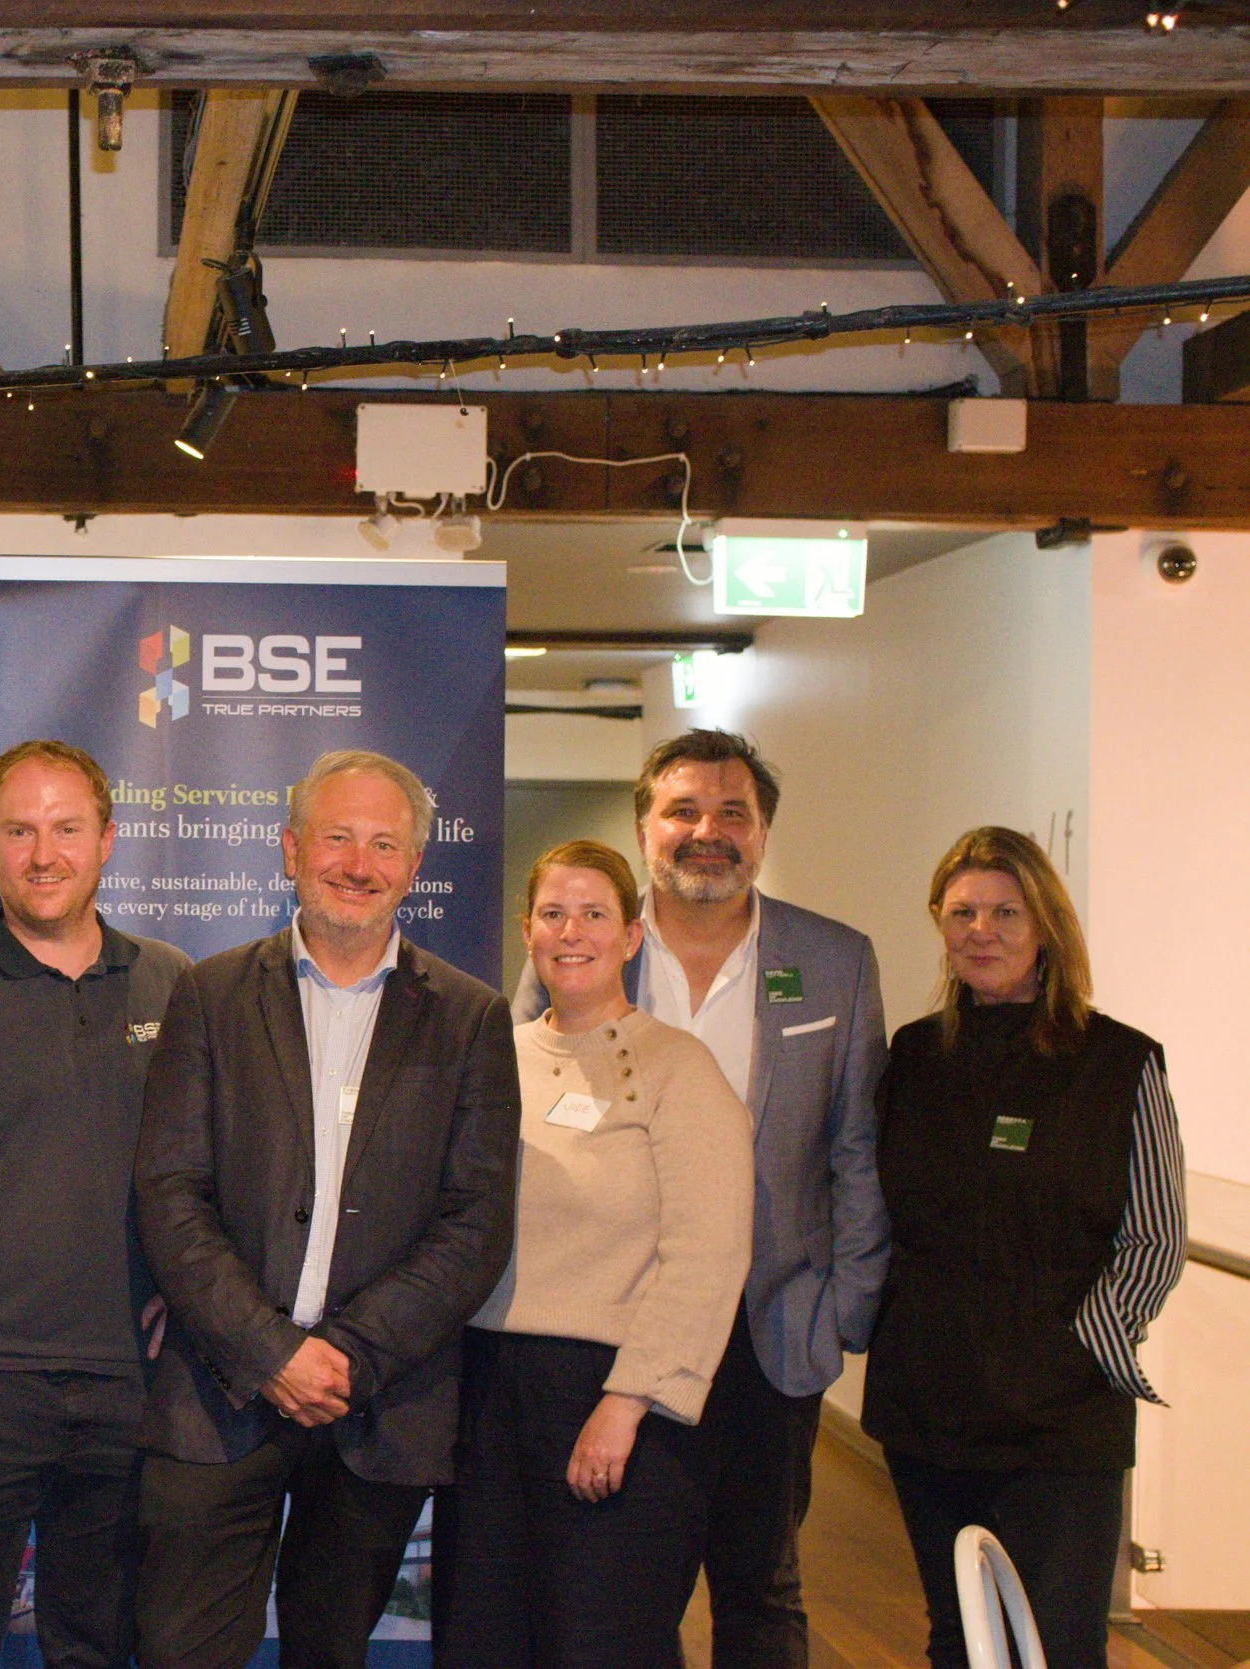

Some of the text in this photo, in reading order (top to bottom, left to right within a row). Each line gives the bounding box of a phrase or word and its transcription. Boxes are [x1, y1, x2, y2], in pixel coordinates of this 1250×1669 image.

[202, 634, 362, 693] BSE
[202, 703, 362, 717] TRUE PARTNERS
[111, 780, 167, 811] ding
[173, 784, 278, 806] Services
[424, 787, 440, 808] &
[114, 814, 474, 847] ants bringing life
[98, 872, 453, 894] ative, sustainable, des ions
[118, 902, 168, 921] every
[173, 900, 222, 921] stage
[227, 898, 249, 917] of
[250, 899, 280, 917] the
